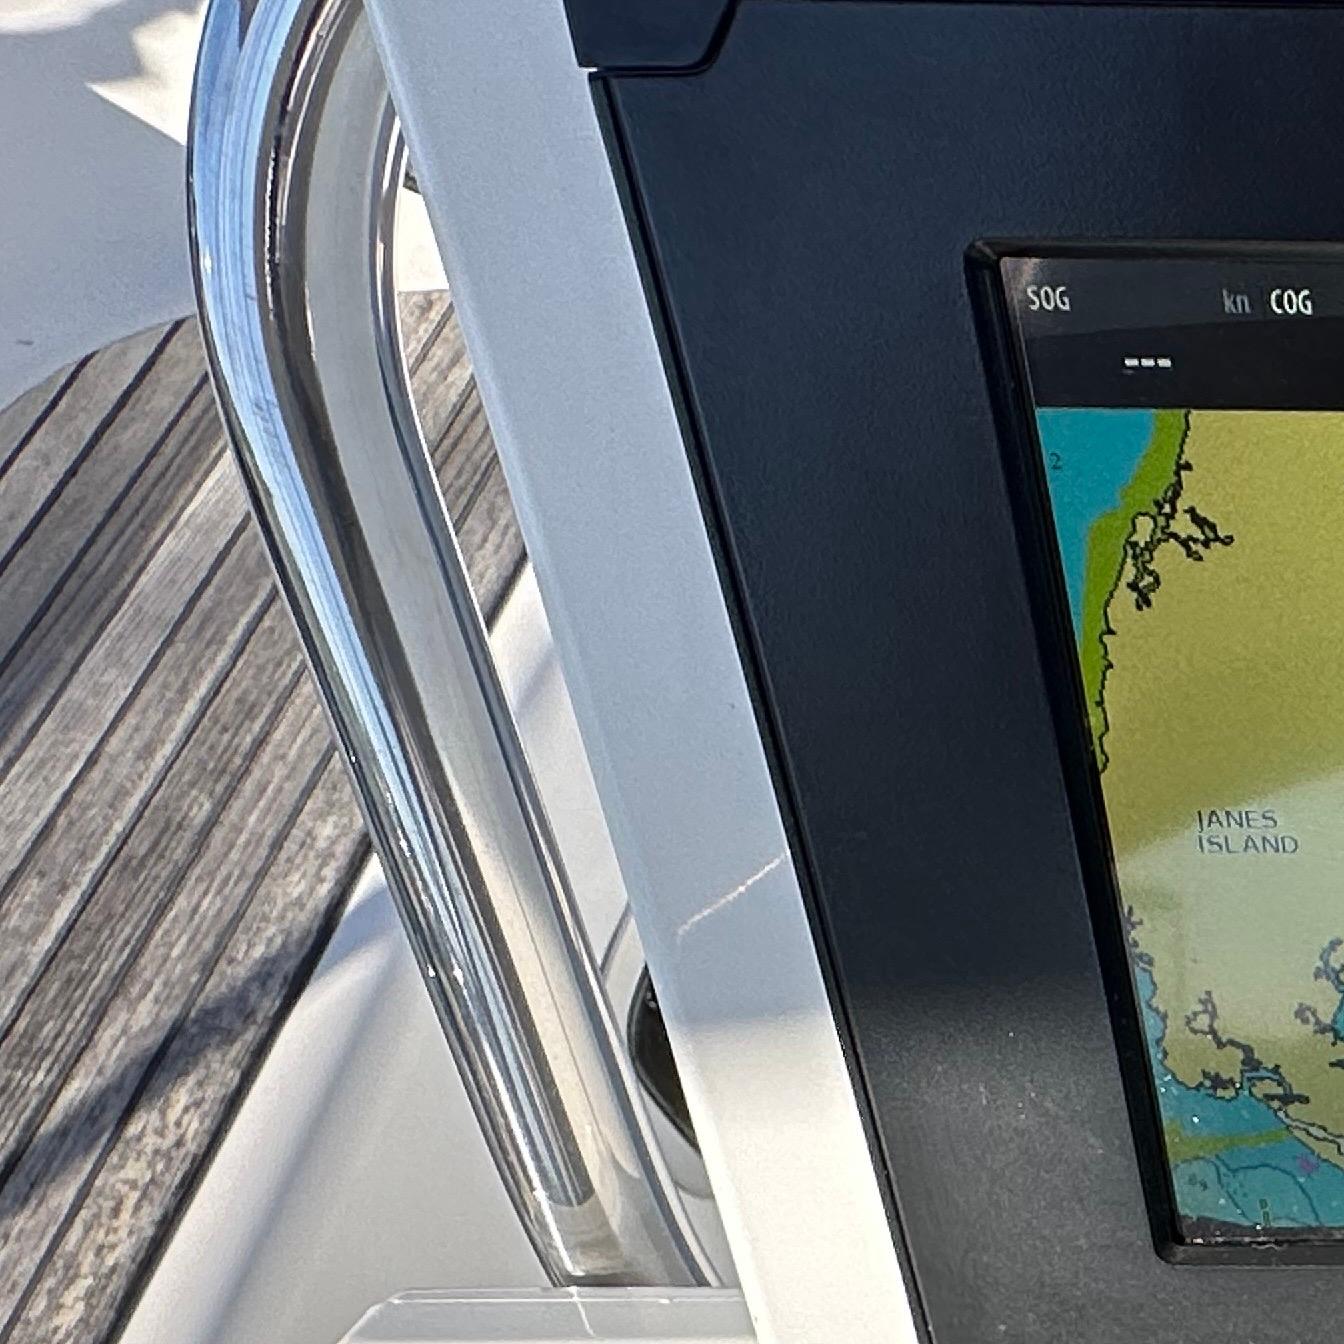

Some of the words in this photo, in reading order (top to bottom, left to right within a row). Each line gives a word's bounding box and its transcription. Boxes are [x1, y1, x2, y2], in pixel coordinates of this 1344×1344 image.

[1026, 285, 1071, 311] SOG
[1221, 288, 1251, 314] kn
[1269, 288, 1314, 317] COG
[1197, 808, 1278, 834] JANES
[1197, 834, 1299, 854] ISLAND
